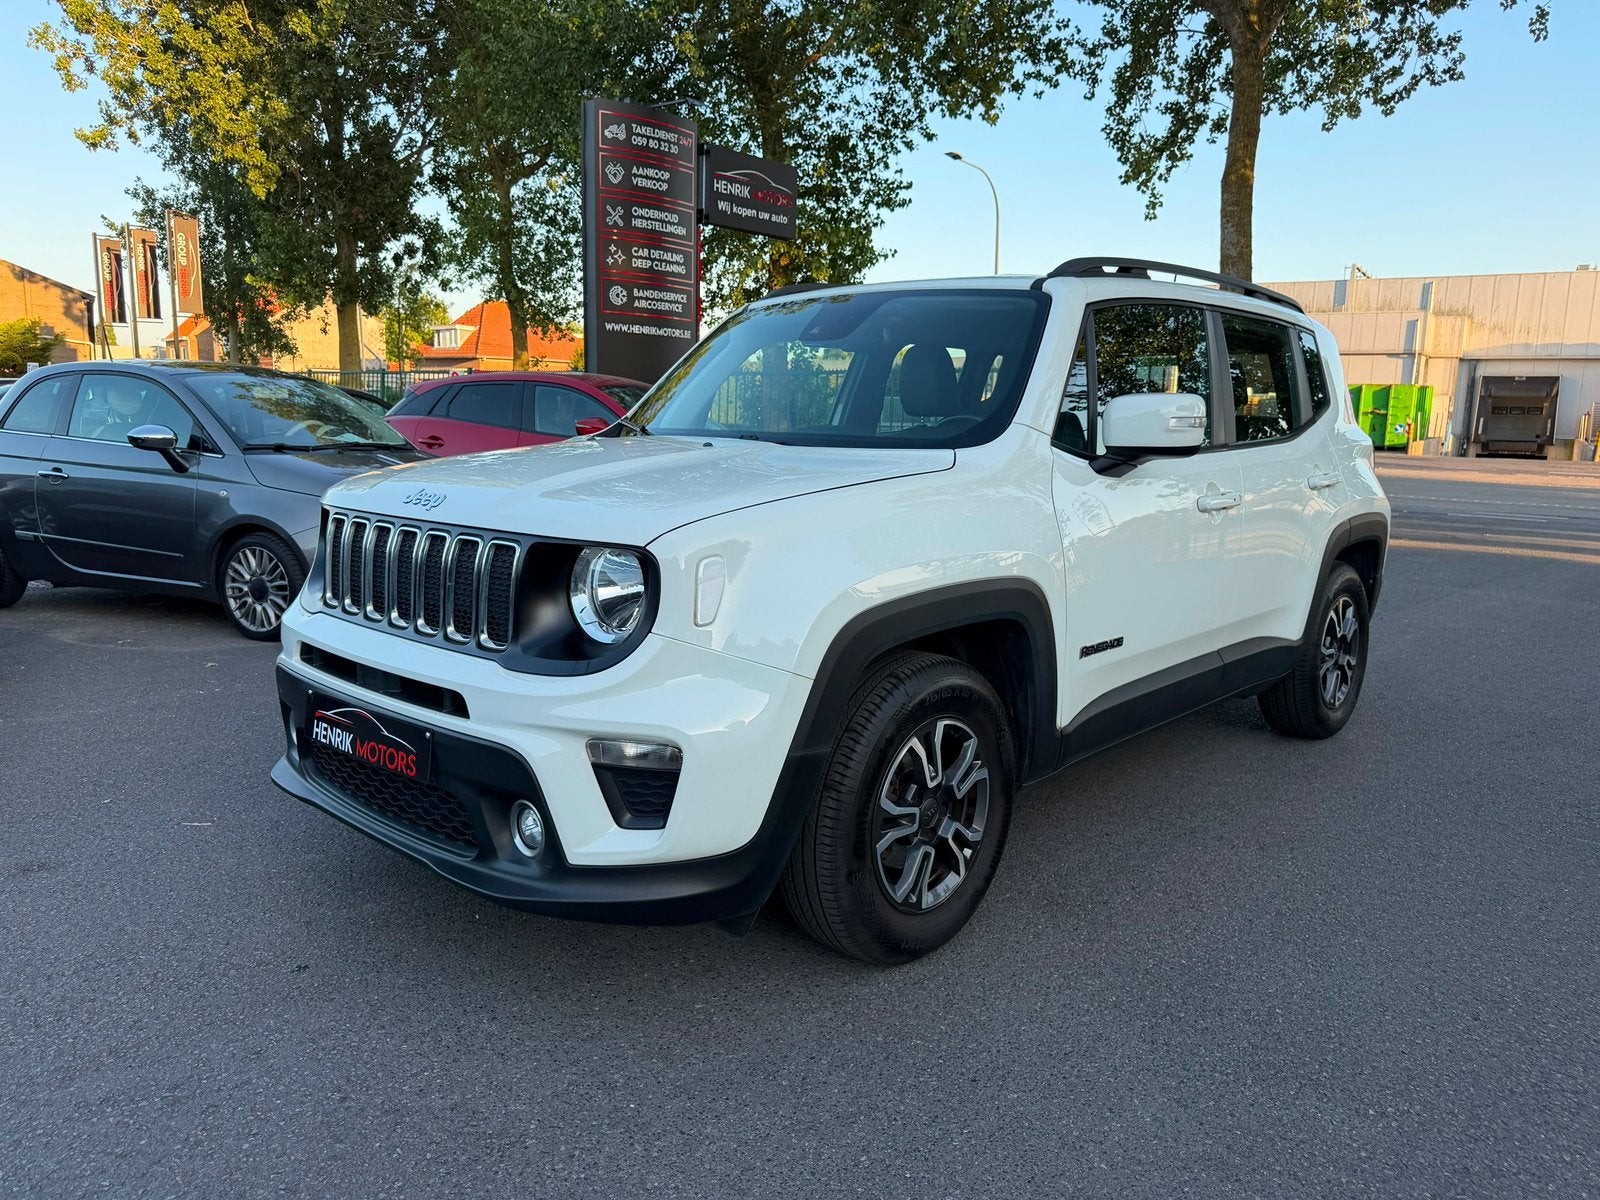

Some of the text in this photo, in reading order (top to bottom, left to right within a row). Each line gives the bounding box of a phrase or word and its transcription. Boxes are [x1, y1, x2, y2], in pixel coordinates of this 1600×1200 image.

[631, 123, 693, 148] TAKELDIENST 24/7
[631, 136, 679, 154] 059 80 32 30
[631, 165, 671, 181] AANKOOP
[631, 176, 669, 191] VERKOOP
[713, 178, 795, 209] HENRIK MOTORS
[631, 206, 679, 223] ONDERHOUD
[717, 200, 731, 215] Wij
[732, 203, 757, 218] kopen
[758, 211, 770, 221] uw
[631, 218, 687, 236] HERSTELLINGEN
[136, 243, 146, 271] HENRIK
[631, 247, 684, 264] CAR DETAILING
[102, 251, 112, 281] GROUP
[177, 232, 190, 300] GROUP HENRIK
[632, 259, 686, 275] DEEP CLEANING
[633, 288, 688, 304] BANDENSERVICE
[633, 300, 683, 313] AIRCOSERVICE
[605, 322, 692, 339] WWW.HENRIKMOTORS.BE
[402, 488, 447, 512] Jeep
[1079, 636, 1124, 660] RENEGADE
[312, 719, 417, 777] HENRIK MOTORS
